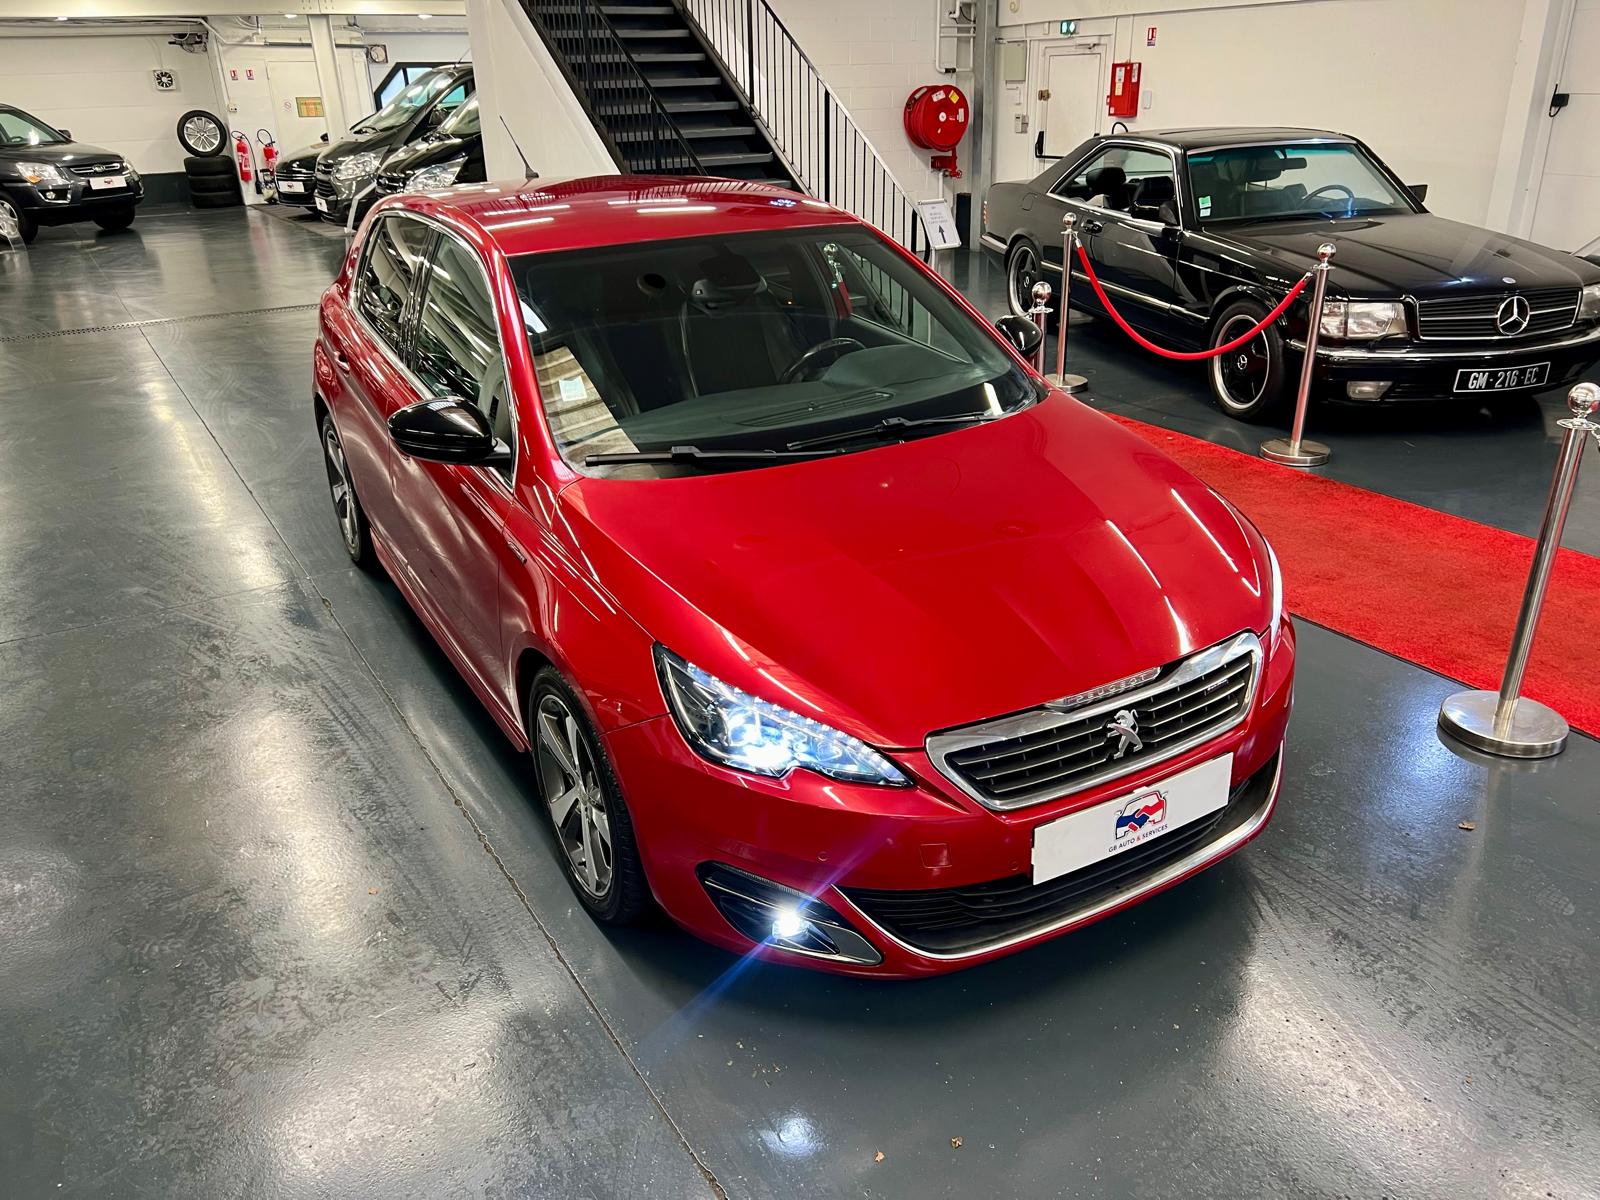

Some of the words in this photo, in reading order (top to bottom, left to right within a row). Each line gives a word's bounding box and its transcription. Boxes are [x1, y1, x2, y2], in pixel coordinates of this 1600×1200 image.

[1108, 845, 1118, 853] GB
[1118, 838, 1136, 849] AUTO
[1142, 824, 1168, 839] SERVICES
